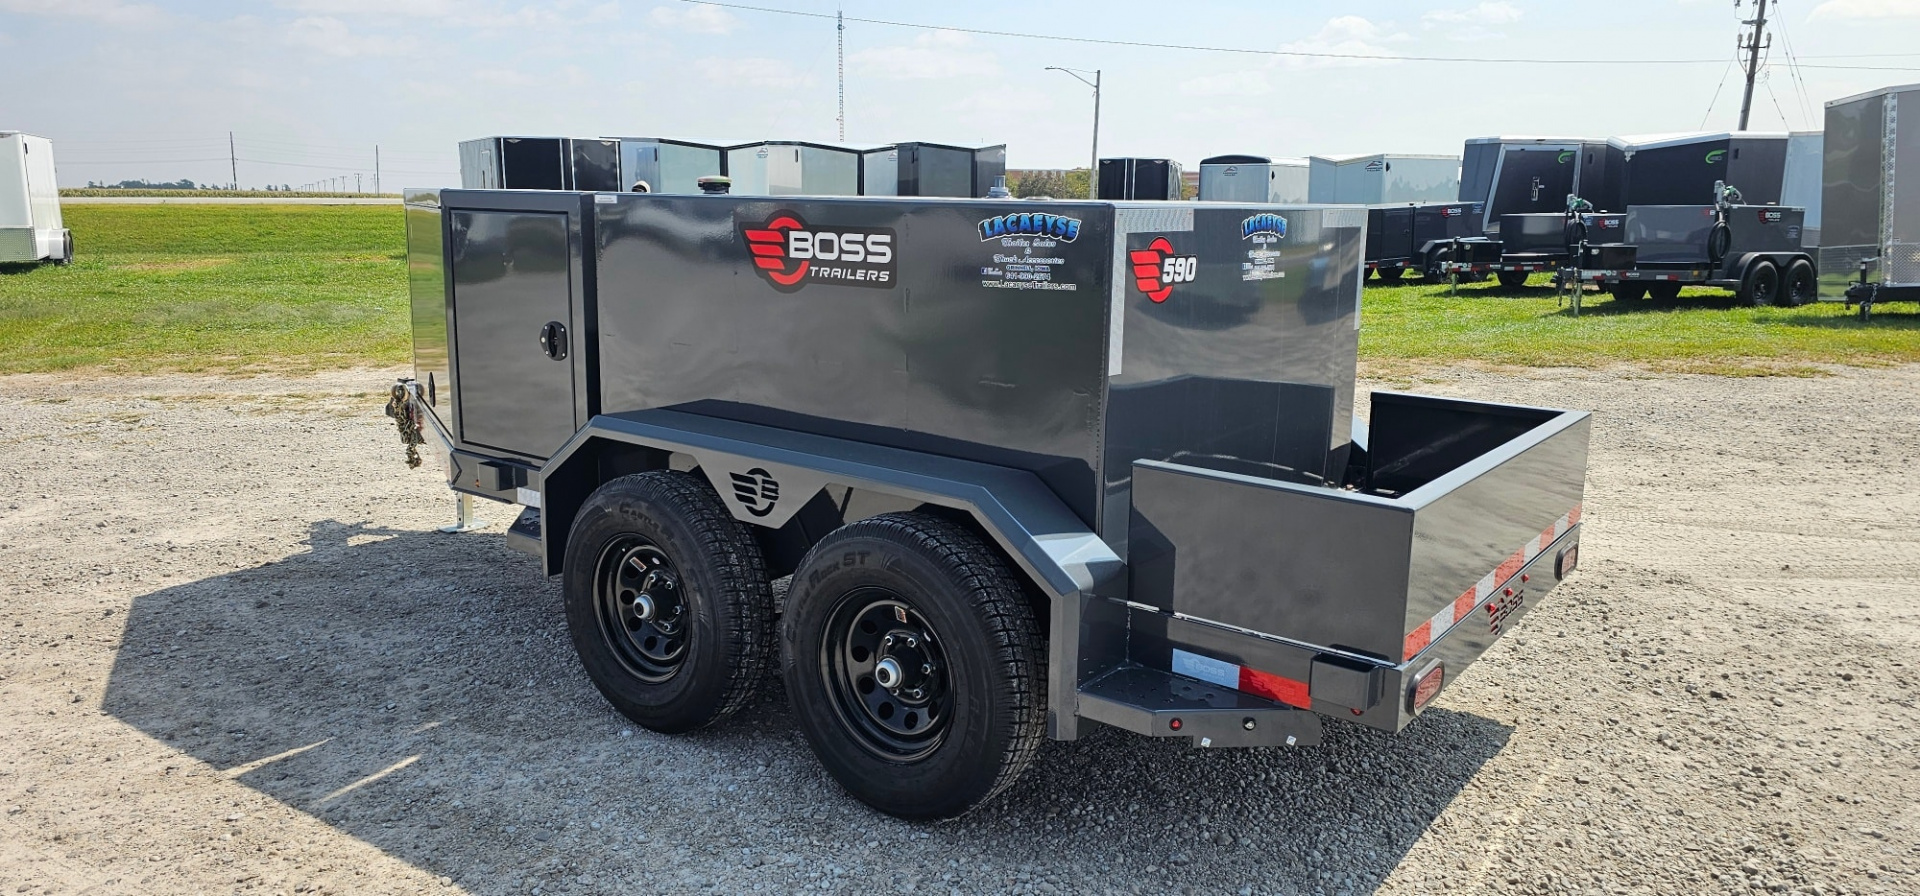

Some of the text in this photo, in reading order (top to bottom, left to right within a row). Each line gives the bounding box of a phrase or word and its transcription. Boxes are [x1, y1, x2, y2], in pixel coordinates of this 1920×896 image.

[980, 213, 1081, 240] LACAEYSE
[1241, 213, 1287, 238] LACAEYSE
[789, 230, 892, 264] BOSS
[809, 266, 890, 282] TRAILERS
[1162, 257, 1197, 284] 590
